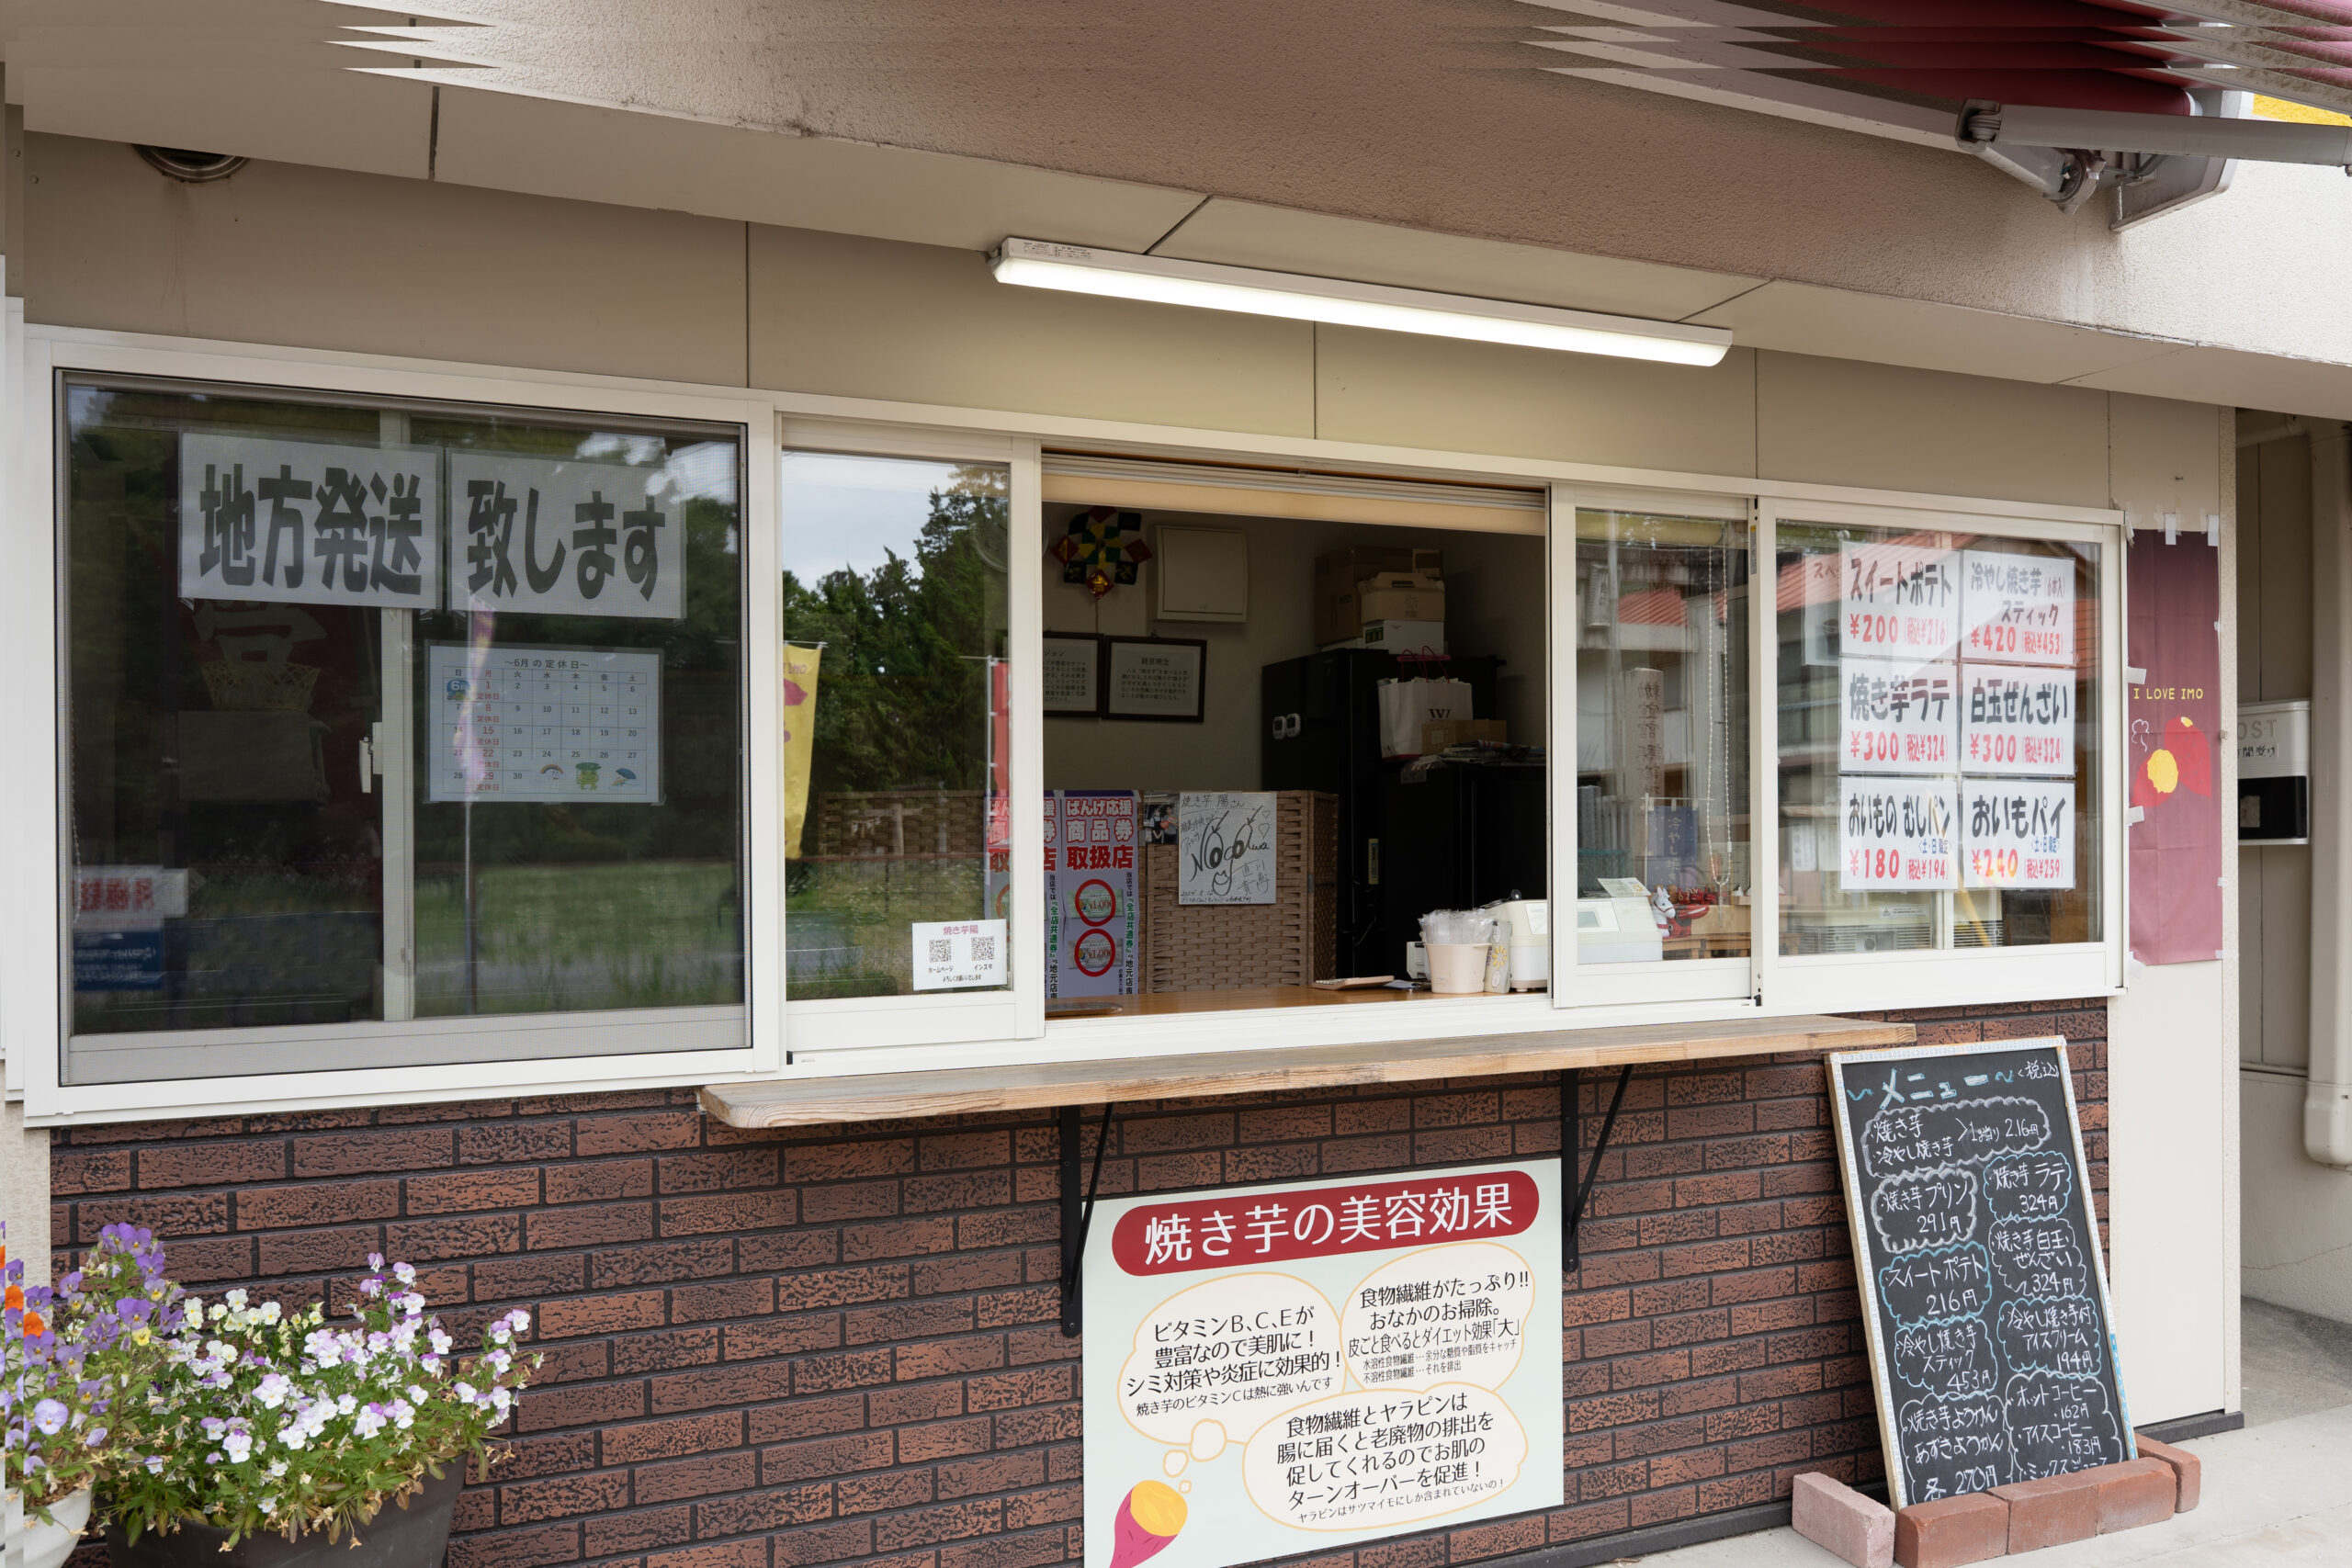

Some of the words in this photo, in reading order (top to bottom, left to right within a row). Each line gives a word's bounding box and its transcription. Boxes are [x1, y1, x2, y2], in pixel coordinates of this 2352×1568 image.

[199, 462, 424, 596] 地方発送
[467, 479, 666, 602] 致します
[1849, 558, 1952, 608] スイートポテト
[1971, 561, 2041, 597] 冷やし焼き芋
[2001, 600, 2059, 626] スティック
[1849, 614, 1898, 644] ¥200
[1971, 624, 2017, 653] ¥420
[543, 671, 551, 680] 水
[572, 672, 580, 681] 木
[601, 673, 608, 682] 金
[628, 674, 637, 682] 土
[477, 692, 500, 700] 定休日
[1849, 671, 1951, 724] 焼き芋ラテ
[1971, 678, 2067, 727] 白玉ぜんざい
[2133, 689, 2140, 700] I
[2146, 688, 2175, 700] LOVE
[2181, 688, 2203, 700] IMO
[2237, 719, 2277, 740] OST
[1850, 730, 1899, 761] ¥300
[1971, 733, 2017, 763] ¥300
[483, 772, 494, 780] 29
[1066, 798, 1134, 817] ばんげ応援
[1972, 795, 2066, 839] おいもパイ
[1066, 819, 1134, 843] 商品券
[1067, 844, 1134, 871] 取扱店
[1849, 848, 1899, 879] ¥180
[1972, 848, 2018, 878] ¥240
[1874, 1113, 1924, 1143] 焼き芋
[2005, 1118, 2039, 1137] 2.16円
[1877, 1136, 1953, 1166] 冷やし焼き芋
[2019, 1194, 2058, 1213] 324円
[1145, 1182, 1513, 1266] 焼き芋の美容効果
[1917, 1213, 1962, 1234] 291円
[2013, 1251, 2073, 1270] ぜんざい
[2031, 1272, 2073, 1292] 324円
[1370, 1298, 1502, 1330] おなかのお掃除。
[1927, 1289, 1977, 1315] 216円
[1154, 1331, 1315, 1370] 豊富なので美肌に！
[1348, 1317, 1521, 1359] 皮ごと食べるとダイエット効果「大」
[1901, 1325, 1977, 1358] 冷やし焼き芋
[2022, 1328, 2088, 1351] アイスクリーム
[1126, 1349, 1341, 1398] シミ対策や炎症に効果的！
[1924, 1350, 1973, 1372] スティック
[2057, 1351, 2093, 1371] 194円
[1947, 1370, 1991, 1392] 453円
[1907, 1404, 1998, 1434] 焼き芋ようかん
[2061, 1403, 2089, 1419] 162円
[1277, 1411, 1494, 1465] 腸に届くと老廃物の排出を
[1915, 1433, 2004, 1464] あずきようかん
[2022, 1423, 2093, 1445] アイスコーヒー
[2068, 1436, 2101, 1455] 183円
[1286, 1438, 1486, 1486] 促してくれるのでお肌の
[1289, 1461, 1482, 1511] ターンオーバーを促進！
[1955, 1465, 1997, 1495] 270円
